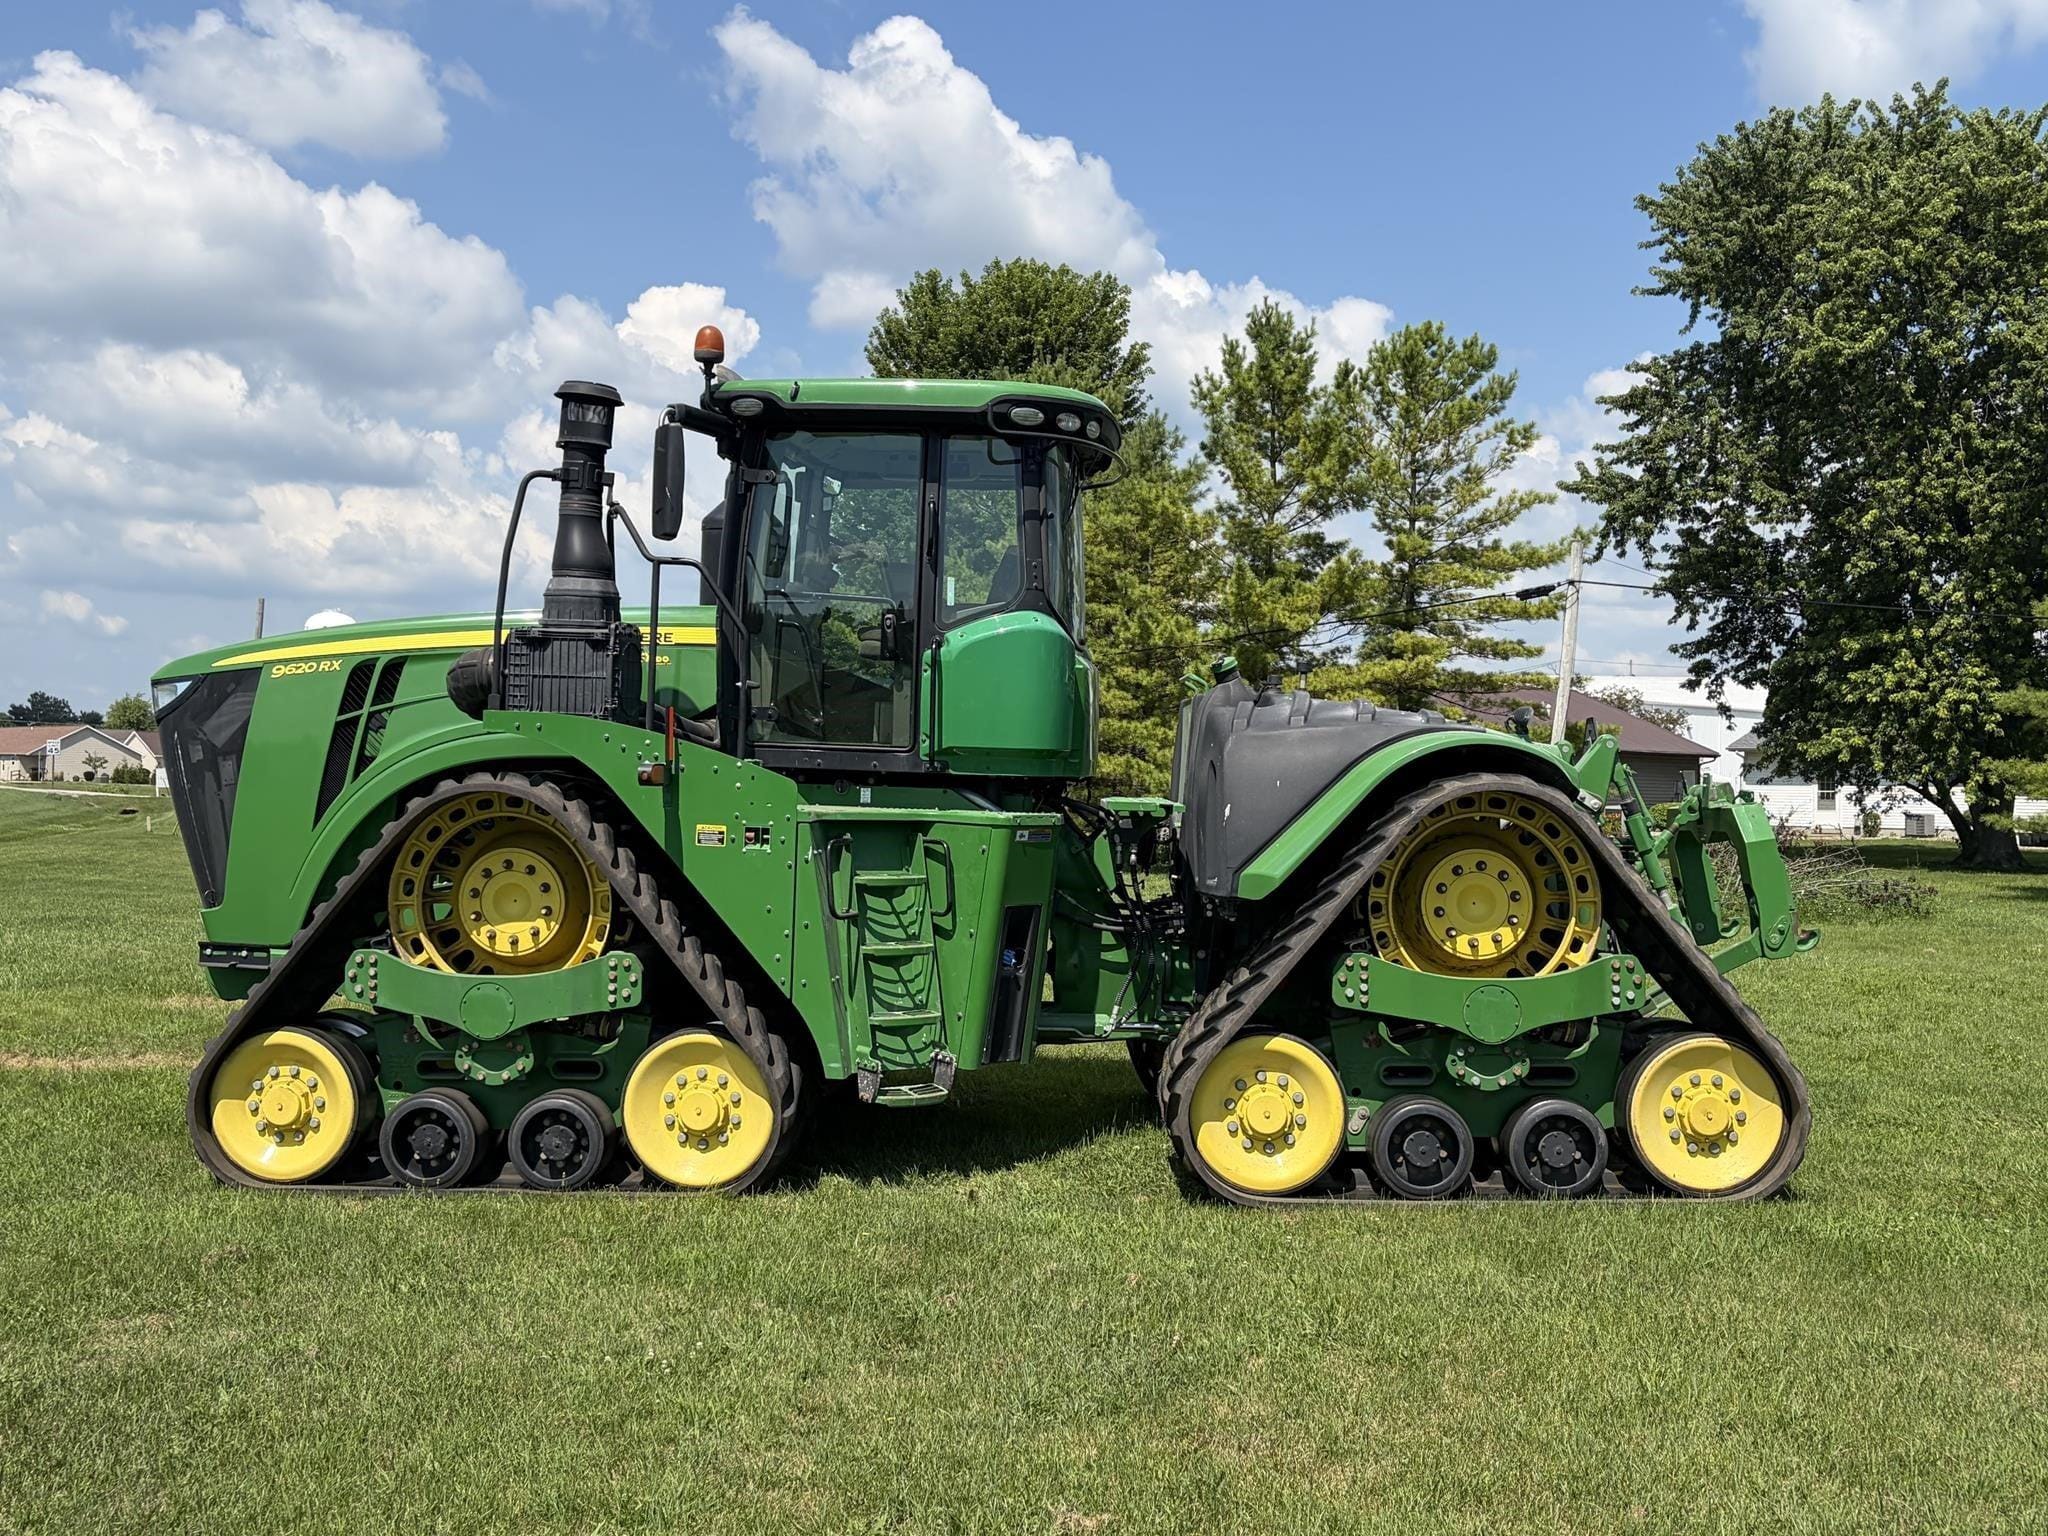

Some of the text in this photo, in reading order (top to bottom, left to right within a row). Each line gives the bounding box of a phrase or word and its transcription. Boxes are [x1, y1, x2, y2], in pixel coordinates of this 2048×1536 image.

[641, 632, 674, 642] ERE
[270, 659, 343, 678] 9620 RX
